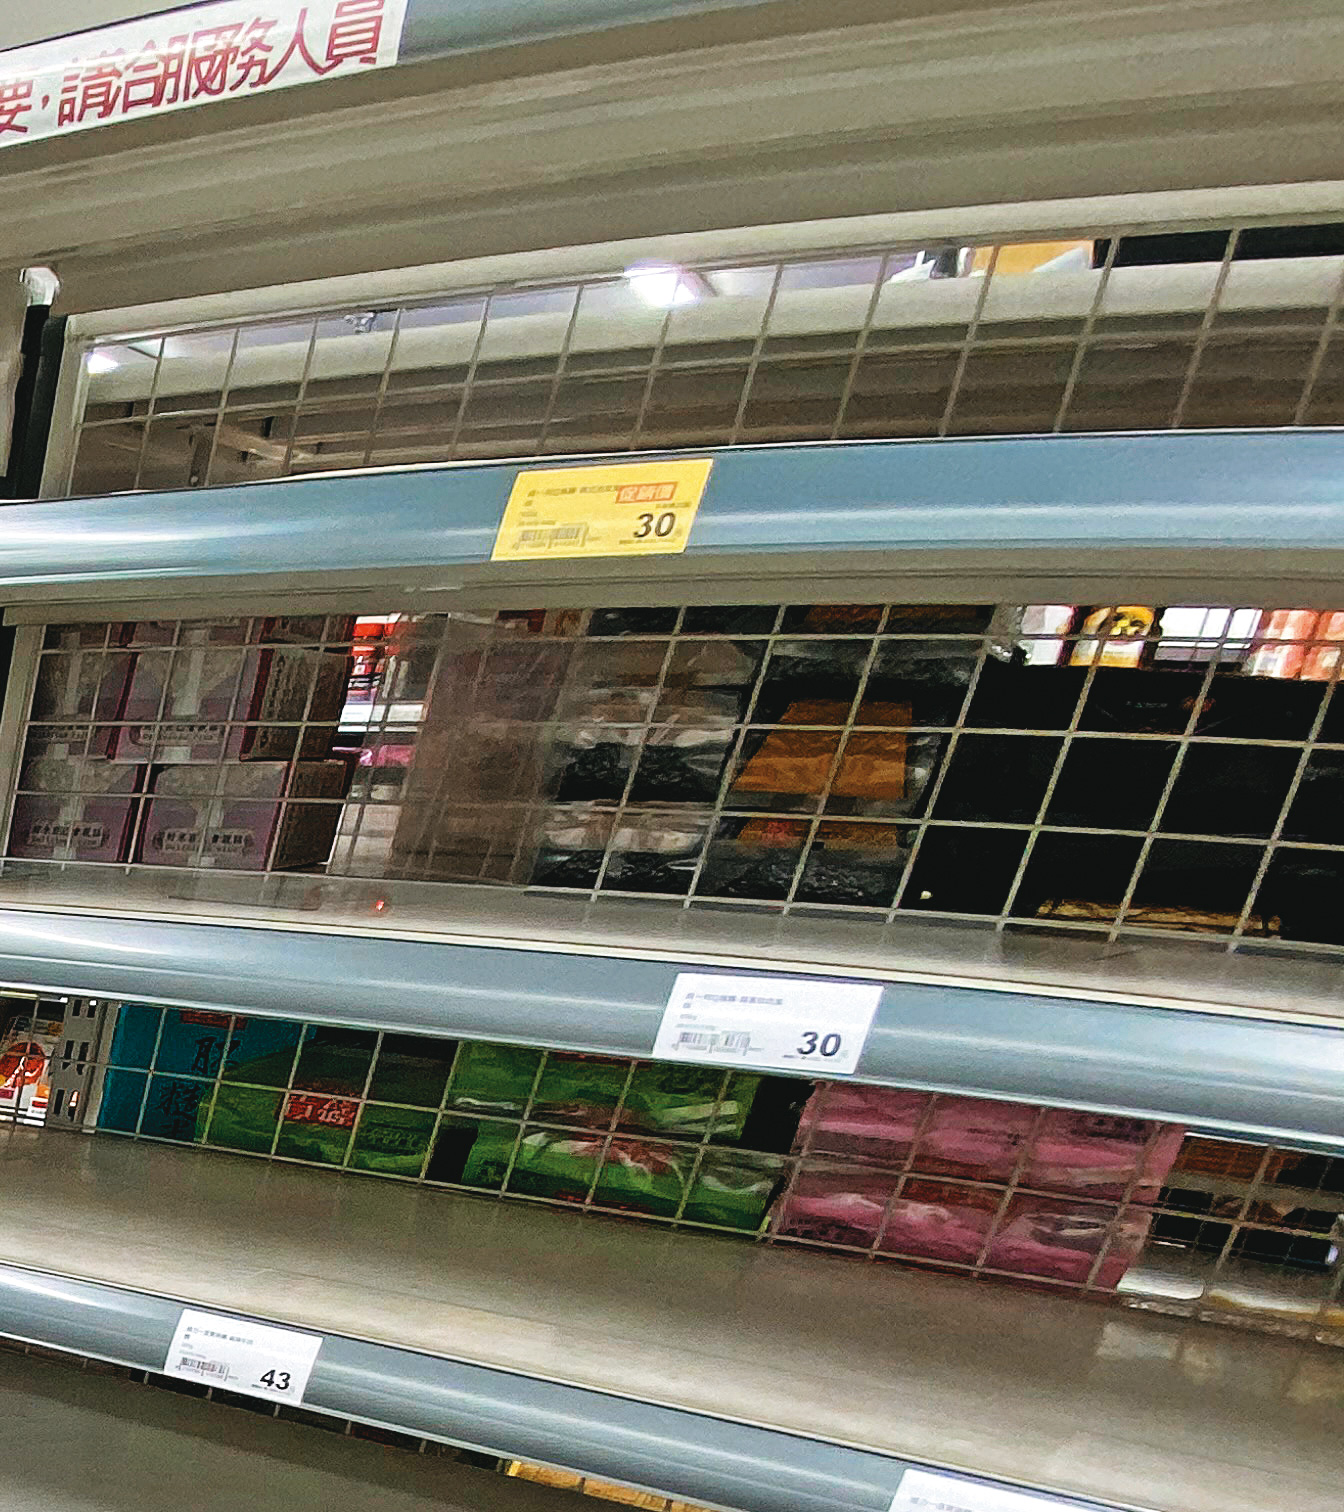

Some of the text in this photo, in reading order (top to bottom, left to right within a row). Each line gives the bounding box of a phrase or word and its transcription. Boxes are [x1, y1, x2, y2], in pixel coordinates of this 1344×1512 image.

[634, 512, 676, 538] 30
[797, 1030, 842, 1057] 30
[260, 1369, 291, 1391] 43
